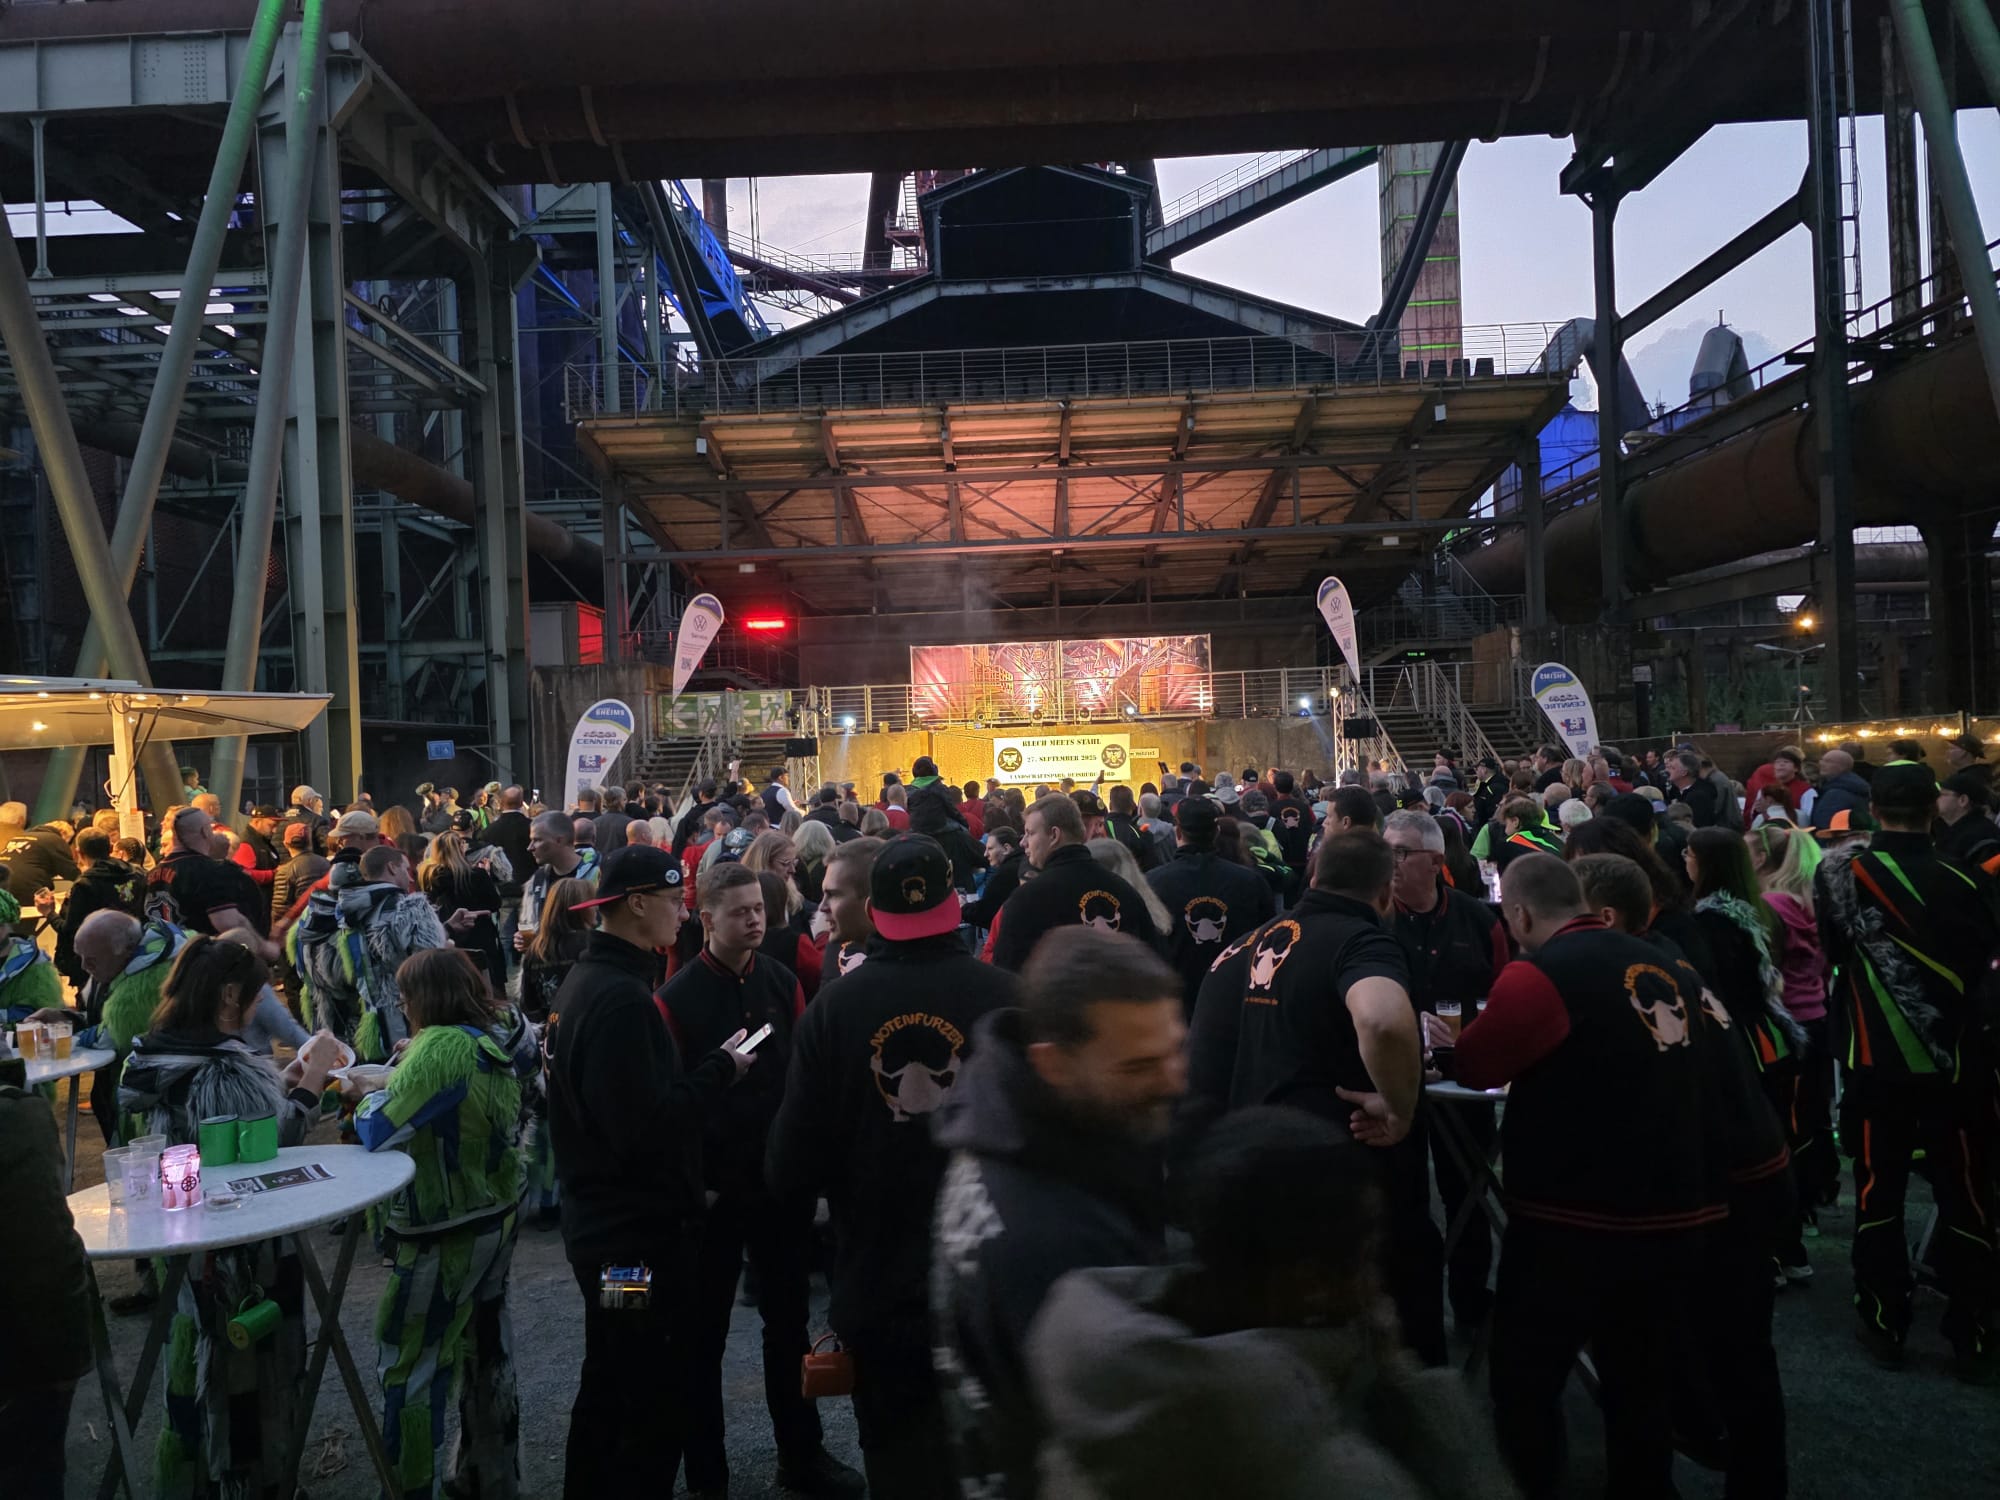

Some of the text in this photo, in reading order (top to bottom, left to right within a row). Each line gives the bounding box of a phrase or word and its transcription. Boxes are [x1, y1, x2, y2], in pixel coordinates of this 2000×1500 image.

[576, 738, 623, 746] CENNTRO
[1022, 739, 1047, 747] BLECH
[1050, 738, 1075, 746] MEETS
[870, 1012, 964, 1049] NOTENFURZER
